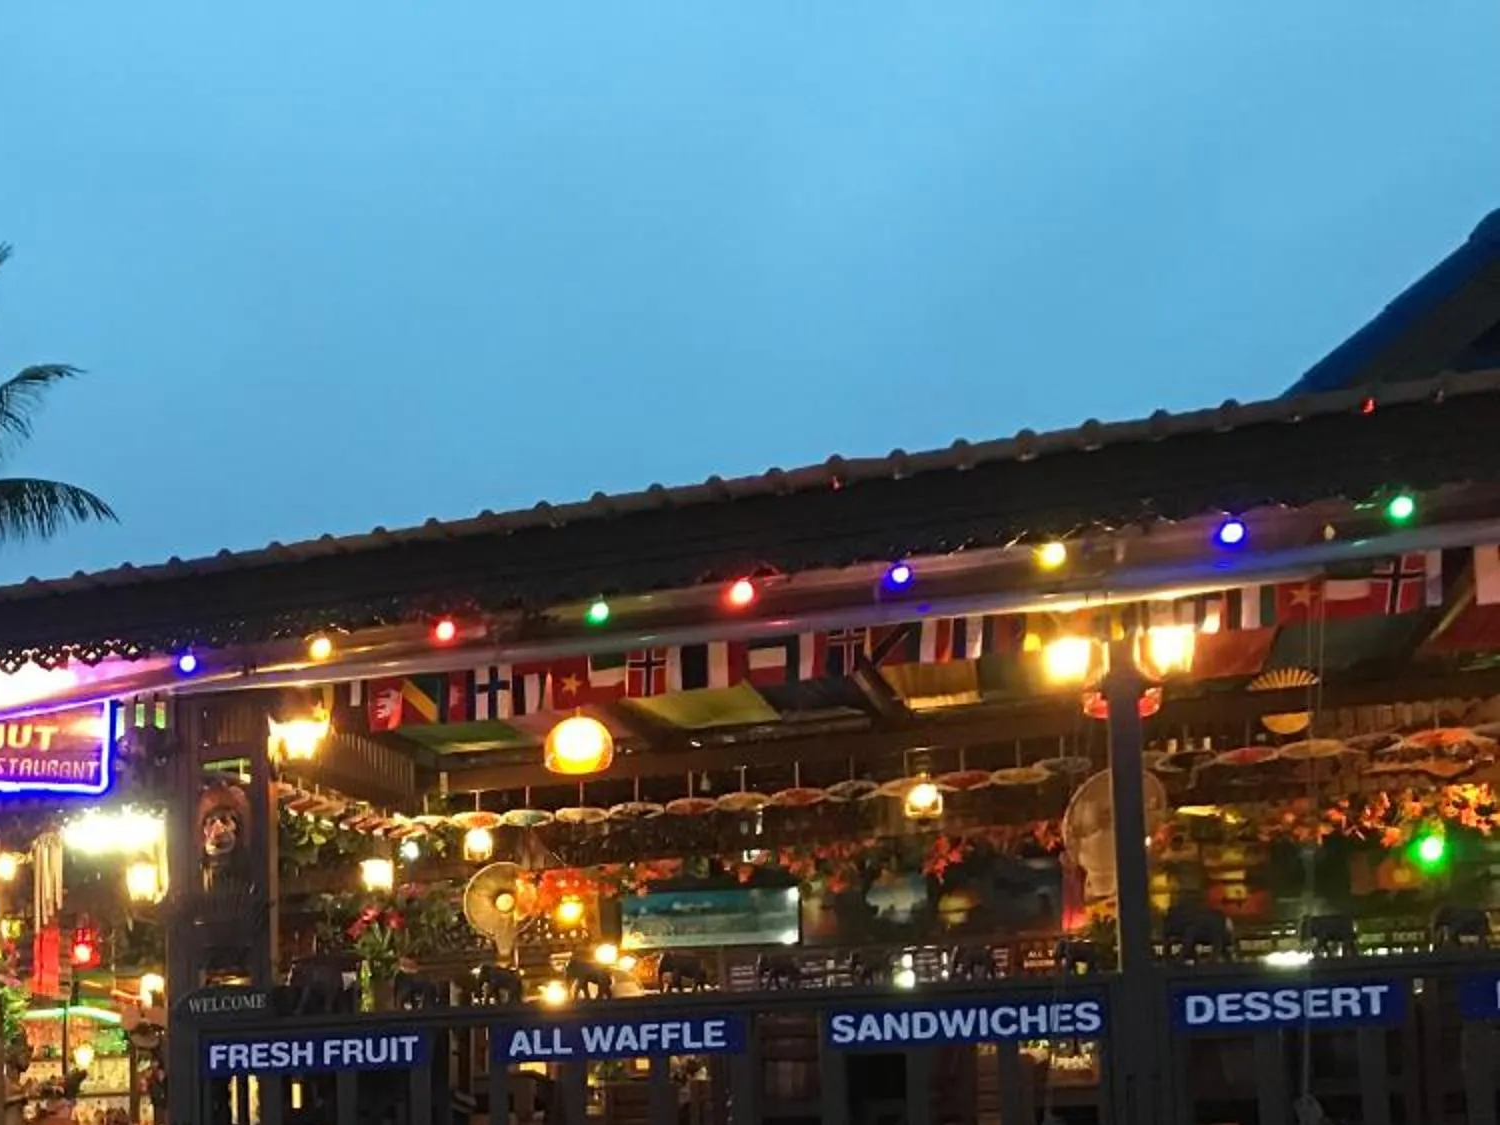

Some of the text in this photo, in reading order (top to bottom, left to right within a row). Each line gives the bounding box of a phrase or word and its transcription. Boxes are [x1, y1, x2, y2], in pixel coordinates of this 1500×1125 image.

[188, 992, 267, 1013] WELCOME
[1184, 984, 1390, 1025] DESSERT
[508, 1019, 728, 1057] ALL WAFFLE
[830, 1001, 1101, 1043] SANDWICHES
[209, 1035, 419, 1070] FRESH FRUIT
